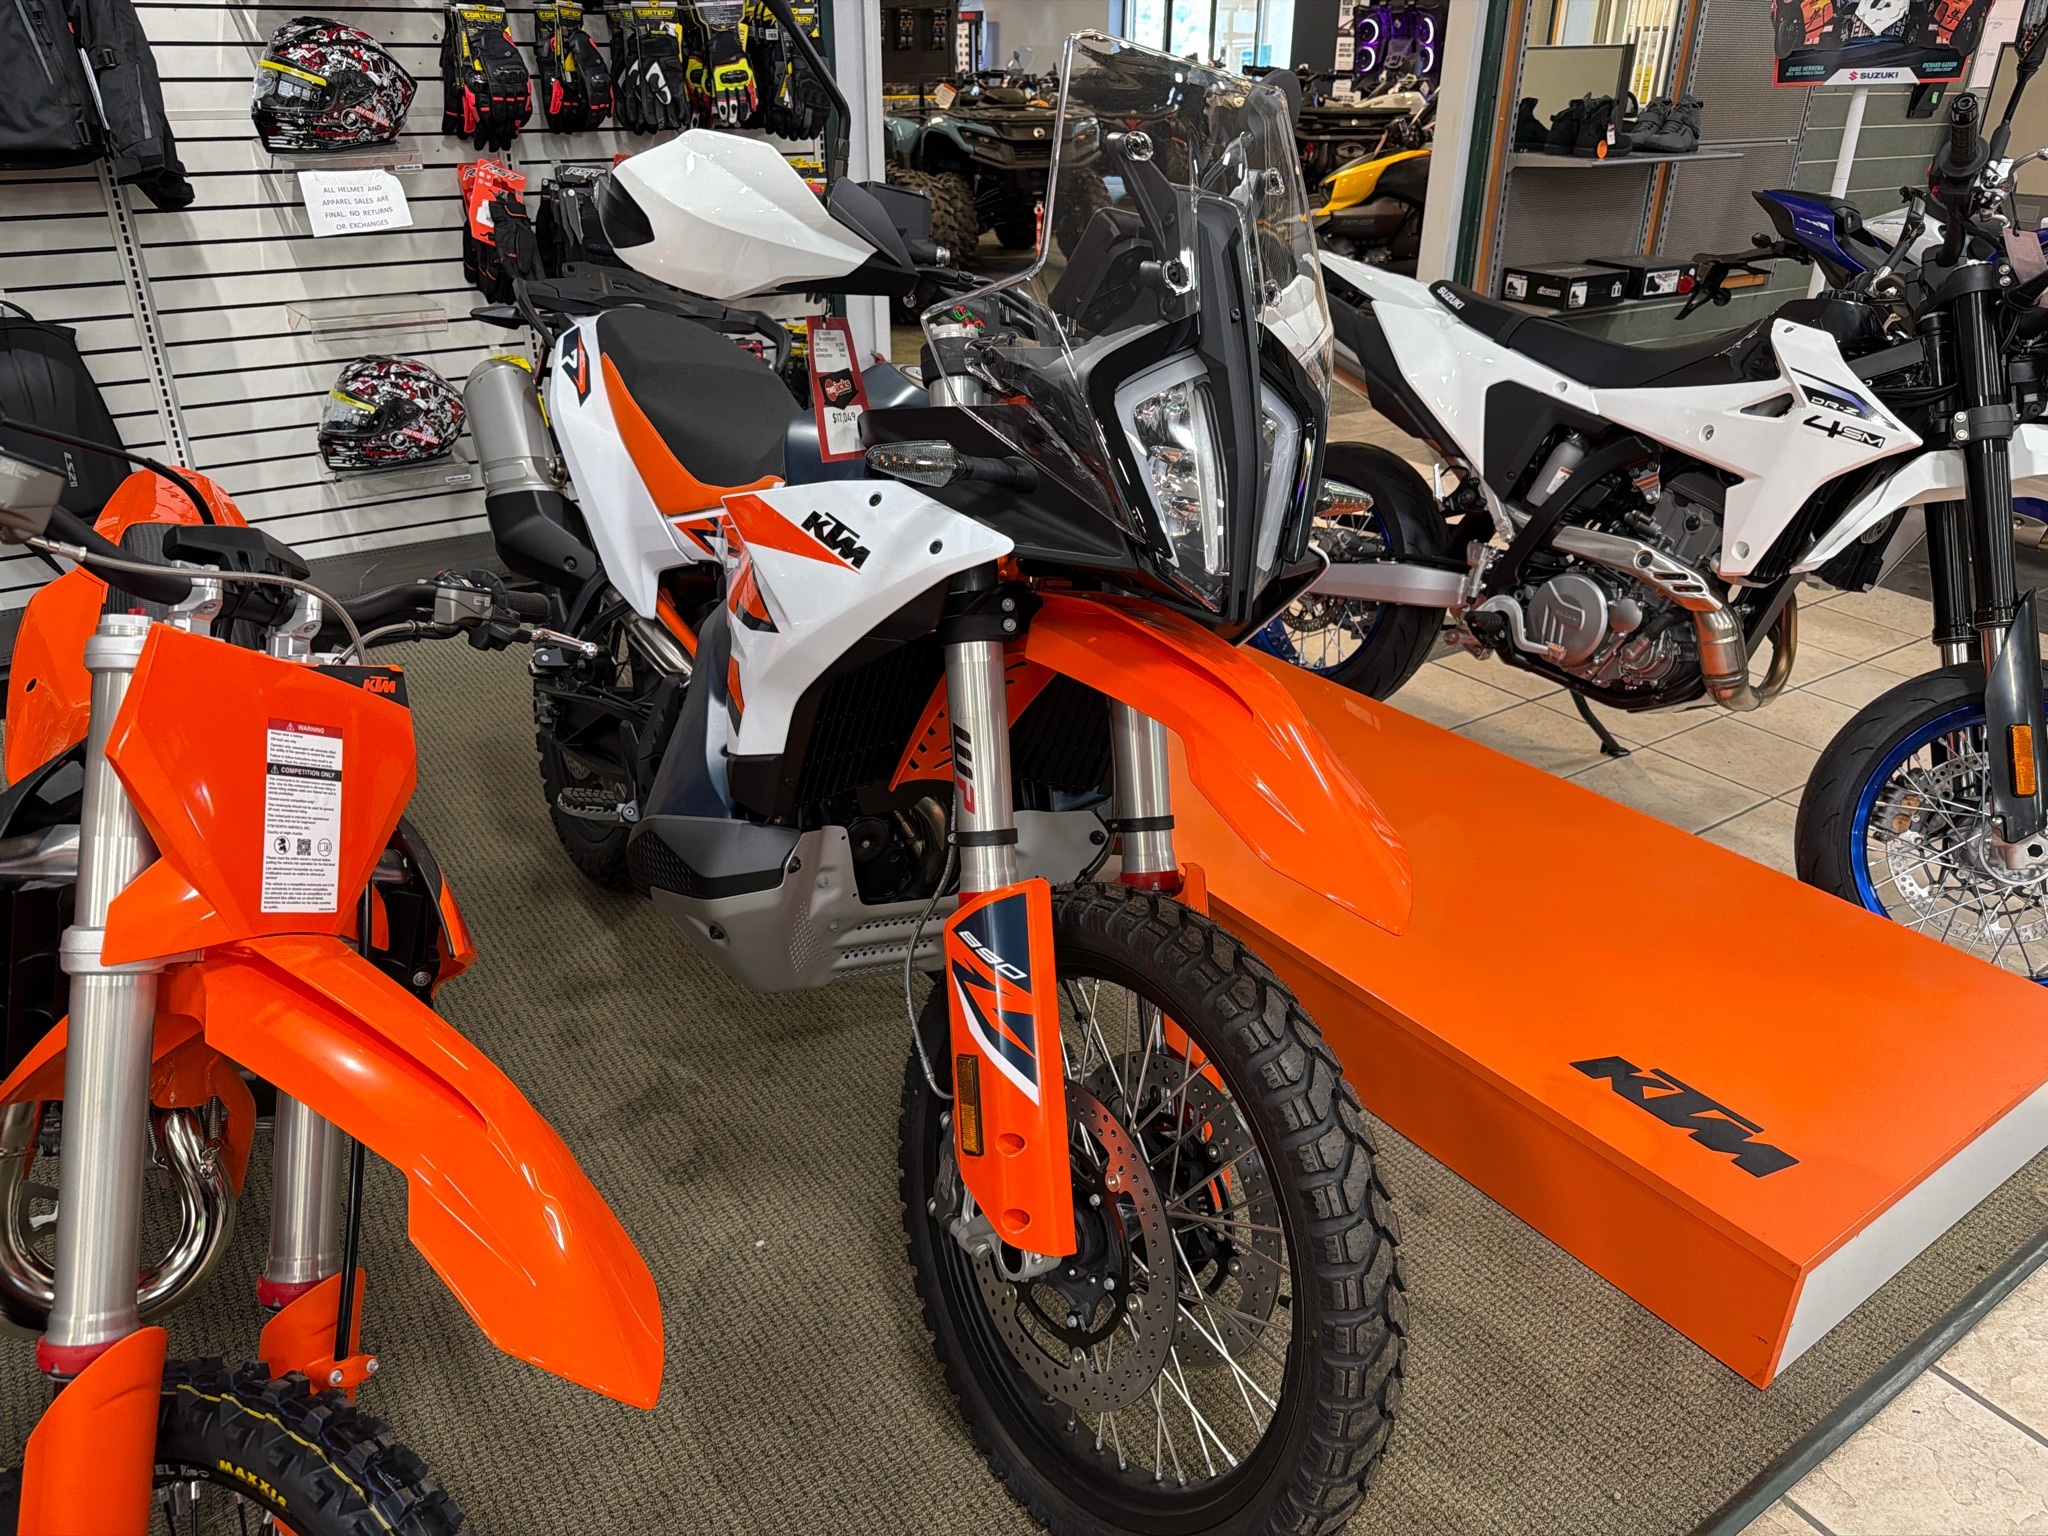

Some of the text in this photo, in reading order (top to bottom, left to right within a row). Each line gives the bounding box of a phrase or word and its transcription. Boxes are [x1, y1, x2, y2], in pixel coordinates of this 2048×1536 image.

[463, 11, 501, 20] CORTECH
[1859, 71, 1899, 80] SUZUKI
[481, 163, 525, 181] RST
[564, 166, 607, 177] RST
[323, 184, 382, 194] ALL HELMET AND
[322, 197, 351, 207] APPAREL
[354, 196, 374, 205] SALES
[325, 210, 347, 219] FINAL.
[363, 206, 393, 216] RETURNS
[336, 219, 389, 231] OR EXCHANGES
[1436, 286, 1466, 311] SUZUKI
[1810, 396, 1860, 416] DR-Z
[832, 411, 856, 424] $17,049
[1802, 415, 1886, 449] 4SM
[800, 510, 872, 570] KTM
[363, 675, 396, 694] KTM
[298, 724, 325, 734] WARNING
[280, 765, 336, 779] COMPETITION ONLY
[958, 930, 1028, 981] 890
[1568, 1055, 1801, 1179] KTM
[218, 1459, 288, 1508] MAXXIS
